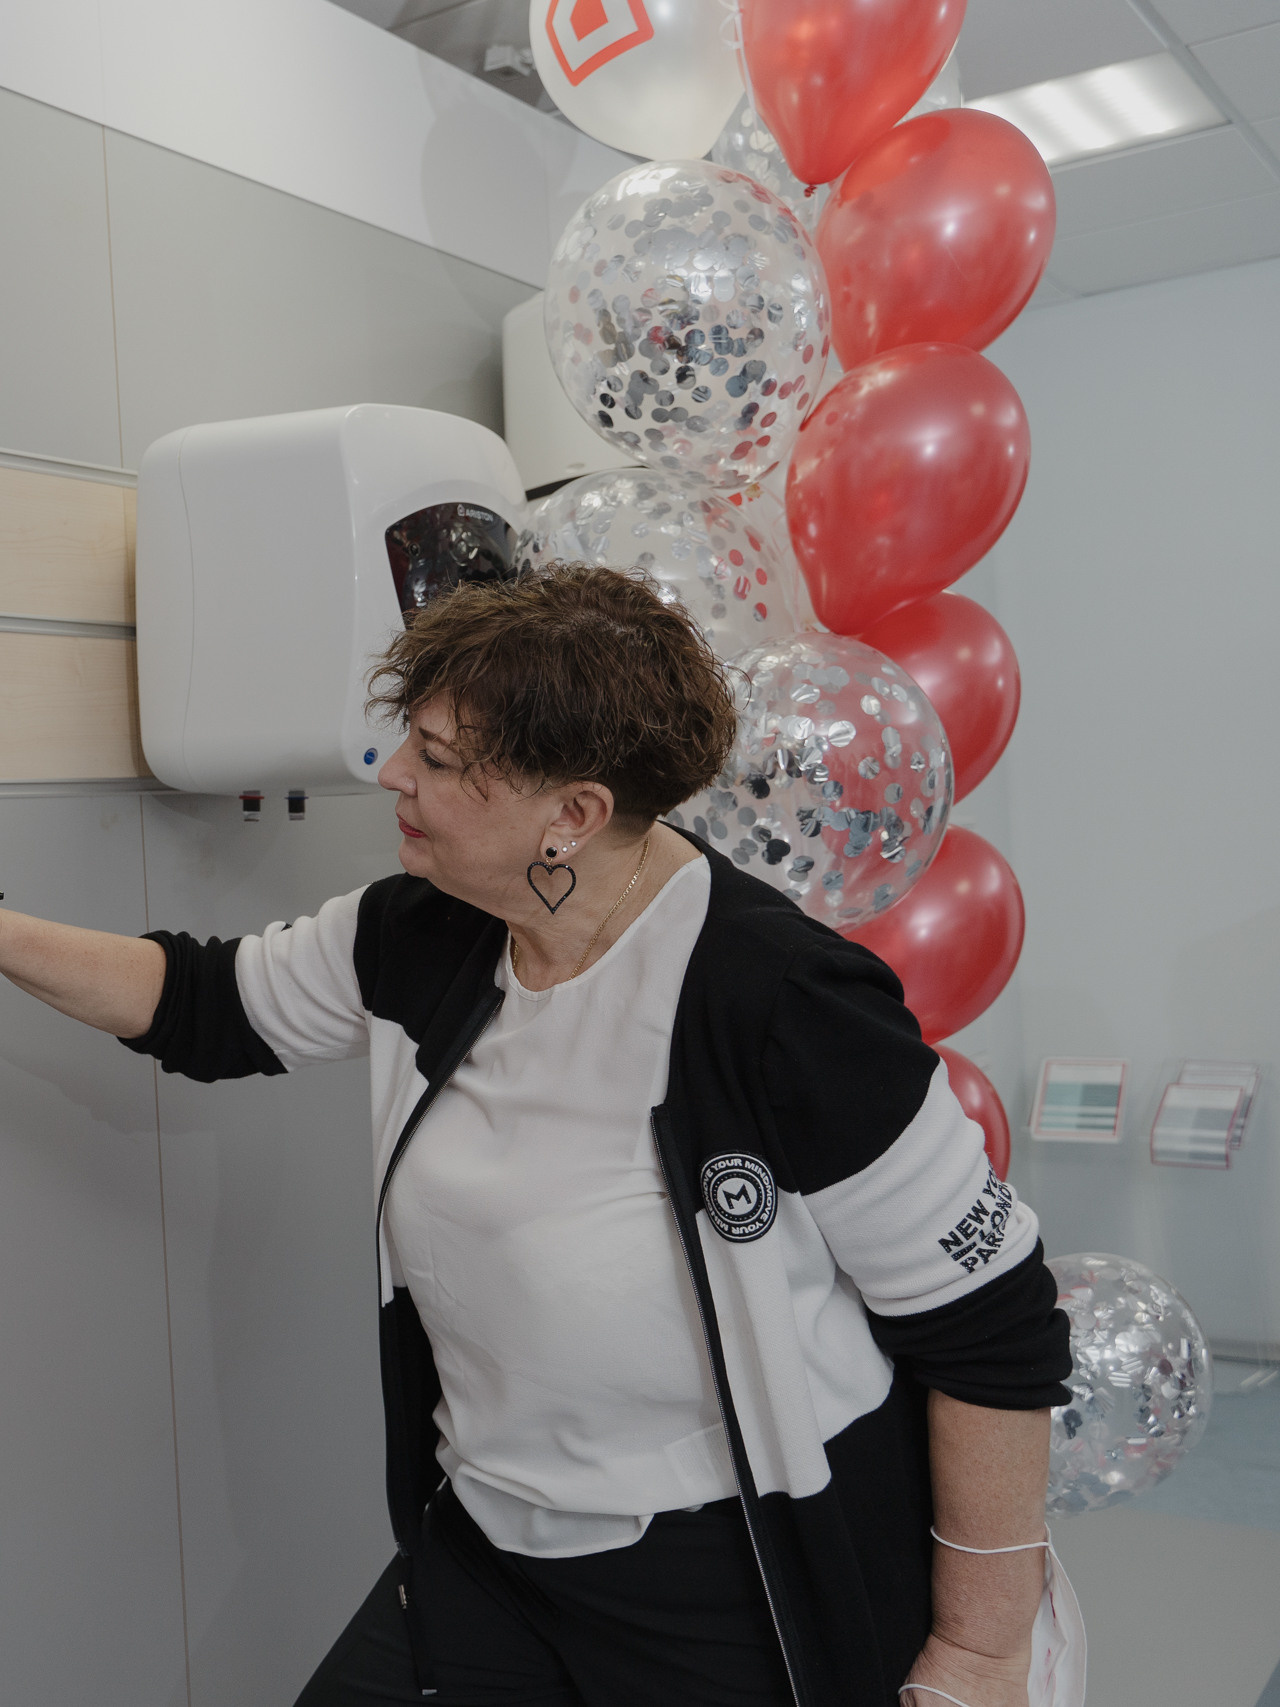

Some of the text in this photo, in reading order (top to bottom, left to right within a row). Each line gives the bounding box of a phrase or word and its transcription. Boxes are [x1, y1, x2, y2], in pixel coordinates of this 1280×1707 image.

[711, 1158, 742, 1171] YOUR
[731, 1222, 763, 1235] YOUR
[937, 1198, 990, 1254] NEW
[978, 1183, 1013, 1243] LOND
